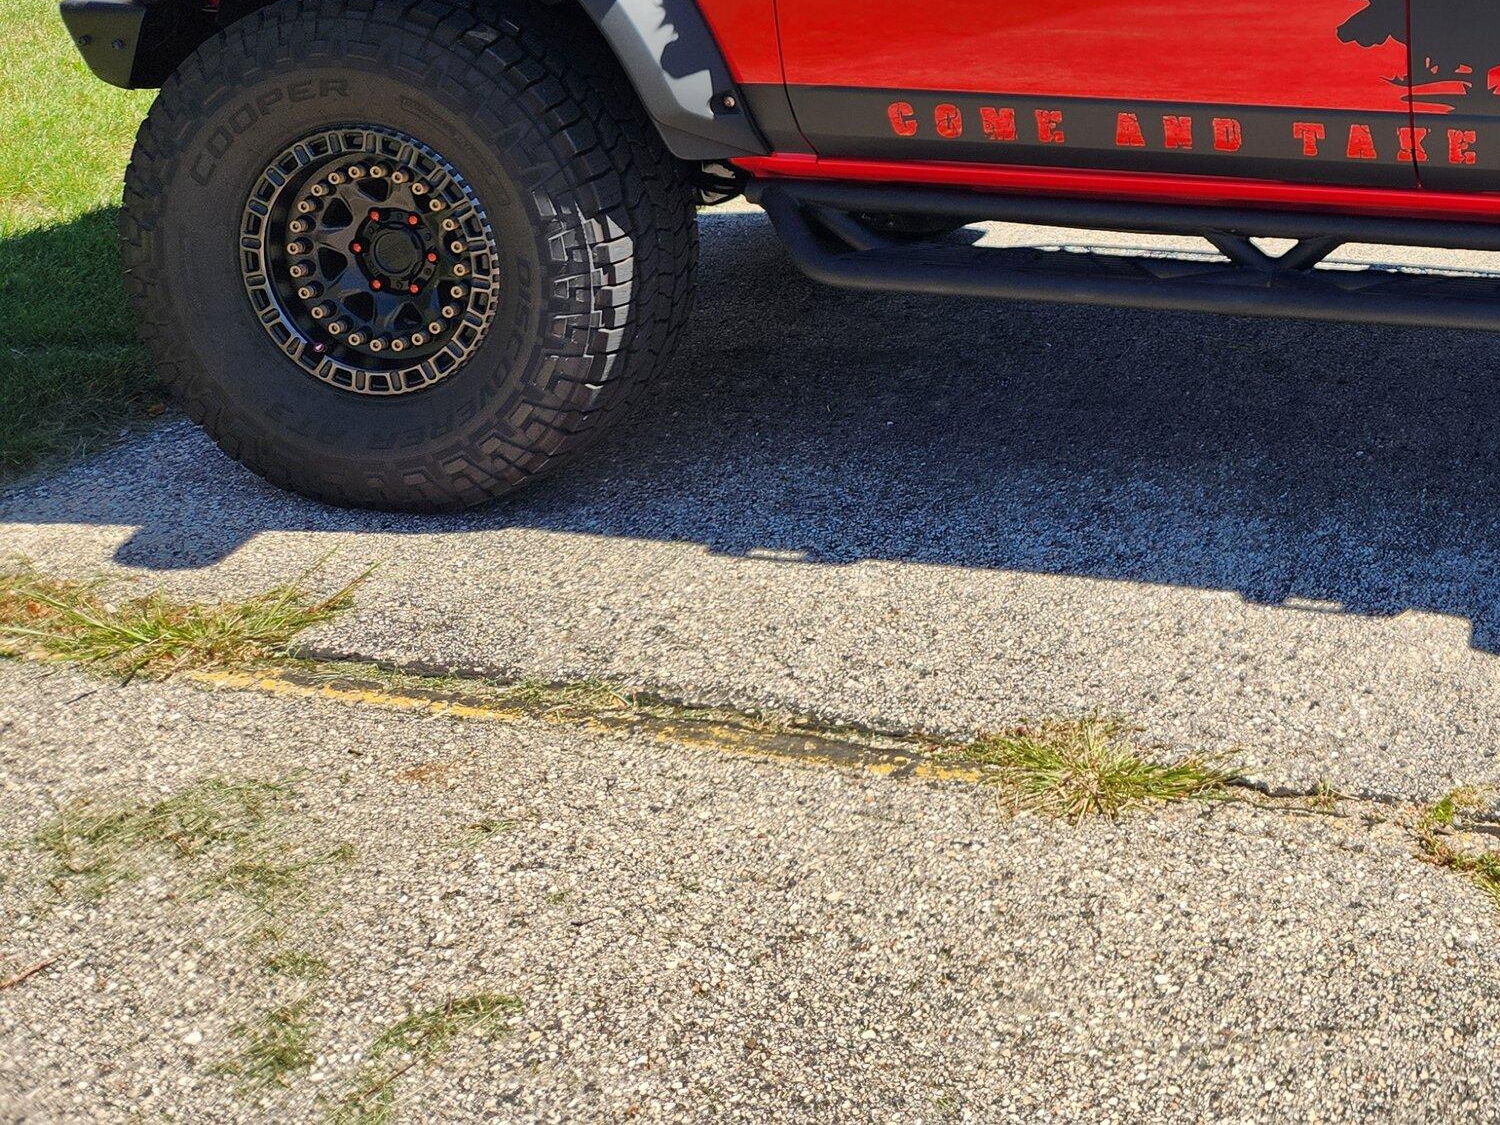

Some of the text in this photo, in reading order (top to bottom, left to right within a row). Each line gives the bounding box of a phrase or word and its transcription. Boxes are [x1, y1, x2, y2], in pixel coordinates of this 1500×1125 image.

[191, 78, 349, 186] COOPER
[887, 101, 1066, 143] COME
[1115, 112, 1242, 152] AND
[1293, 122, 1477, 164] TAKE
